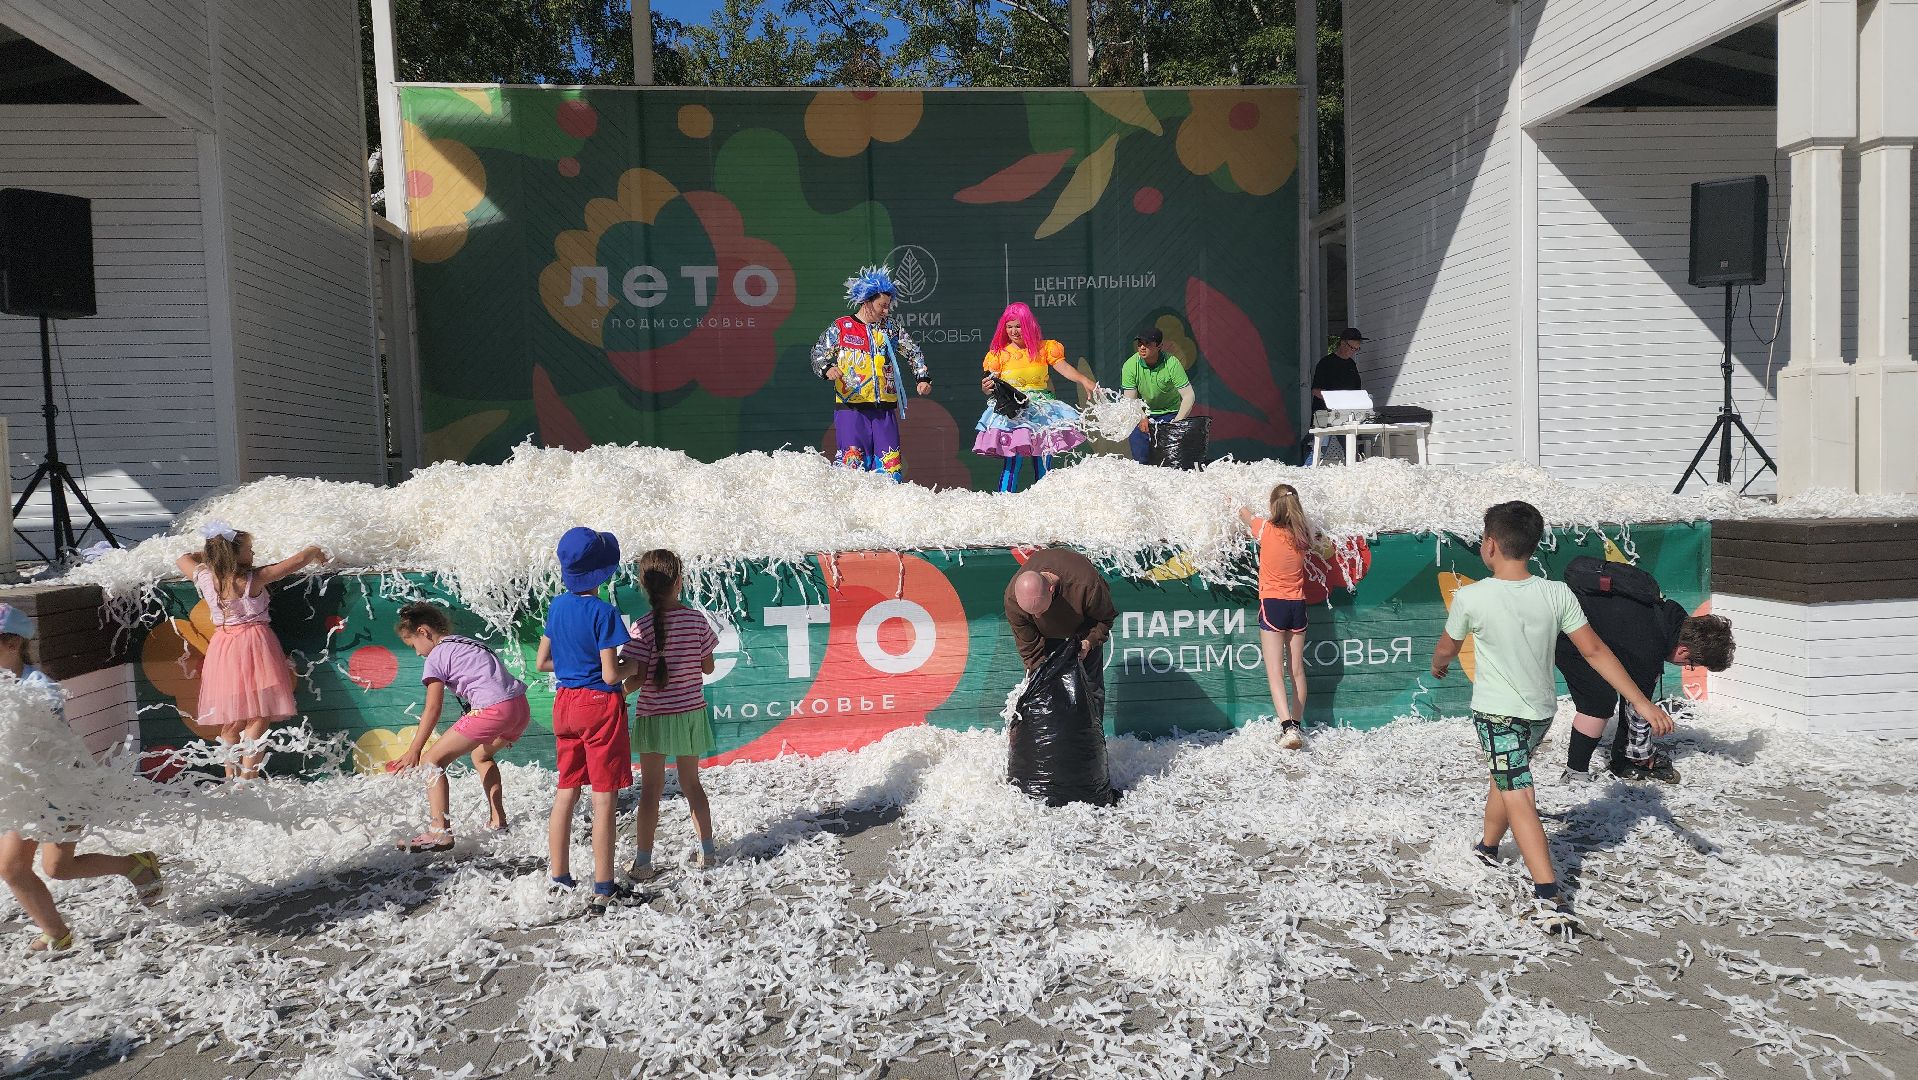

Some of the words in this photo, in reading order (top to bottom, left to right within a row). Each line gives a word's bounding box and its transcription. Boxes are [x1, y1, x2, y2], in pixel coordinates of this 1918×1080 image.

[1034, 271, 1156, 292] ЦЕНТРАЛЬНЫЙ
[1034, 293, 1078, 307] ПАРК
[592, 319, 600, 328] В
[612, 317, 756, 329] ПОДМОСКОВЬЕ
[888, 312, 941, 327] АРКИ
[911, 328, 982, 343] СКОВЬЯ
[1122, 608, 1245, 639] ПАРКИ
[1123, 637, 1412, 676] ПОДМОКОВЬЯ
[713, 694, 896, 720] МОСКОВЬЕ
